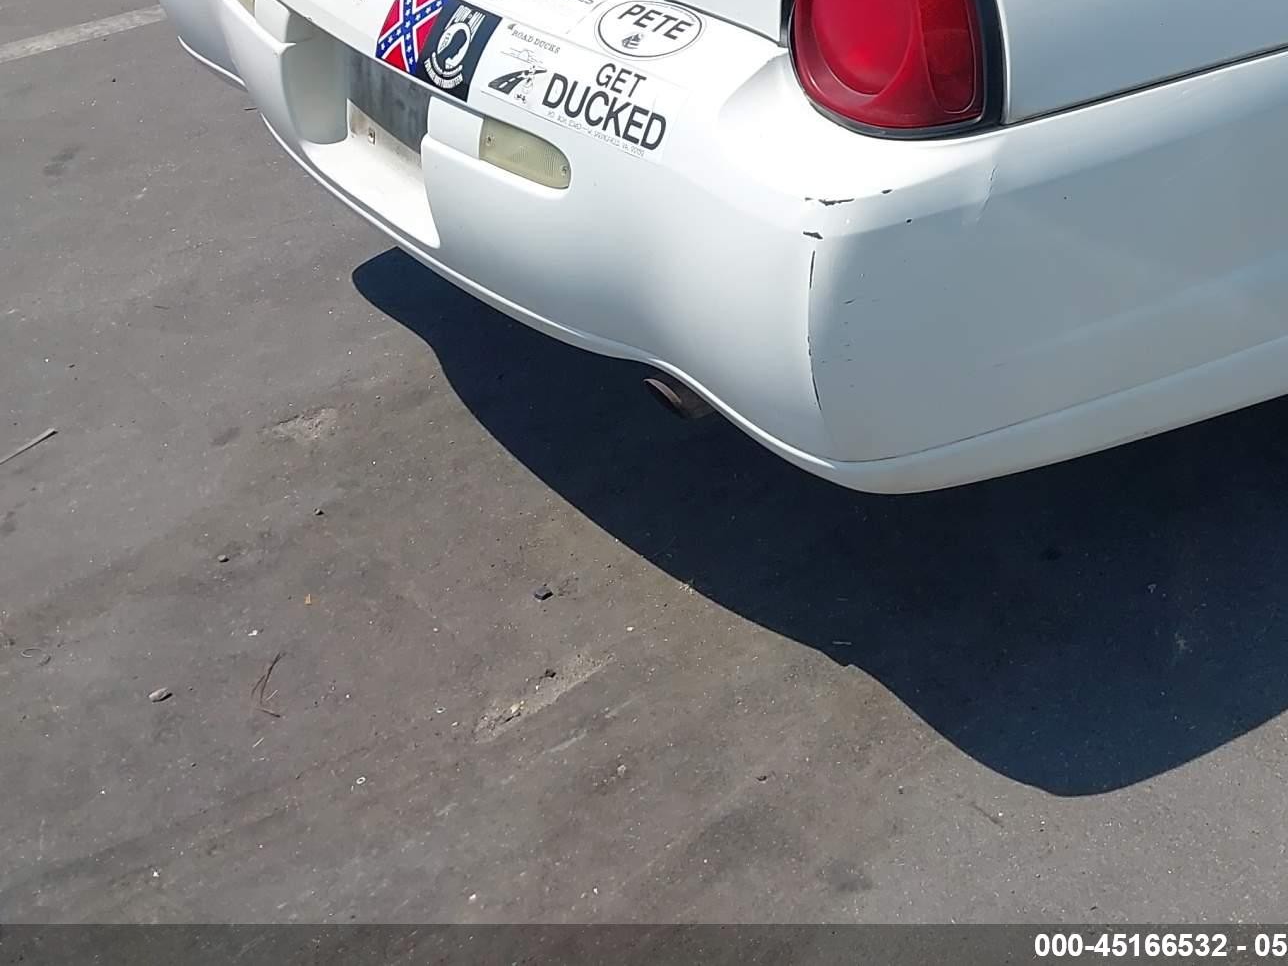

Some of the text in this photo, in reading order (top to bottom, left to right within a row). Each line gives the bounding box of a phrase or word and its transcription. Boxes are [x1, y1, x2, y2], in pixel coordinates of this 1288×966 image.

[617, 3, 694, 40] PETE
[596, 62, 647, 98] GET
[541, 72, 667, 151] DUCKED
